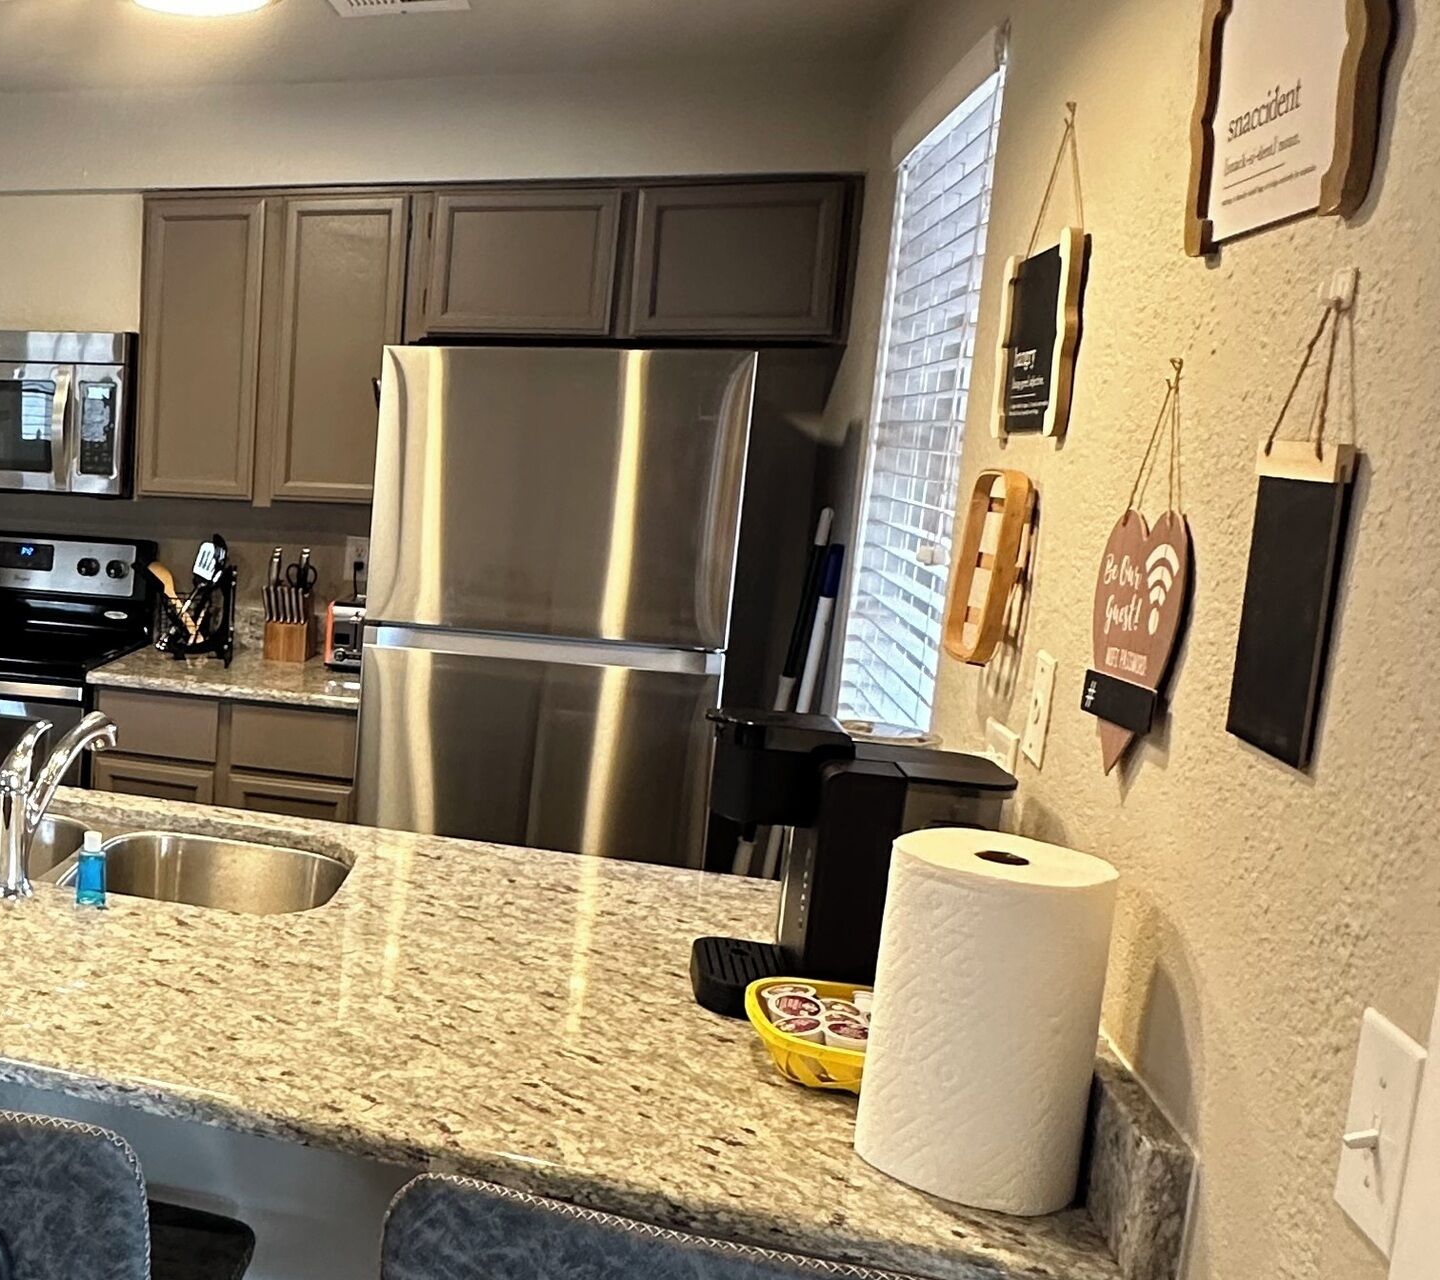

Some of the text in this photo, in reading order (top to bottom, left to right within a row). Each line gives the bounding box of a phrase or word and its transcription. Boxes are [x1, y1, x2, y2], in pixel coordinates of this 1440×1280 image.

[1227, 77, 1302, 142] snaccident
[1103, 553, 1143, 590] Be Our
